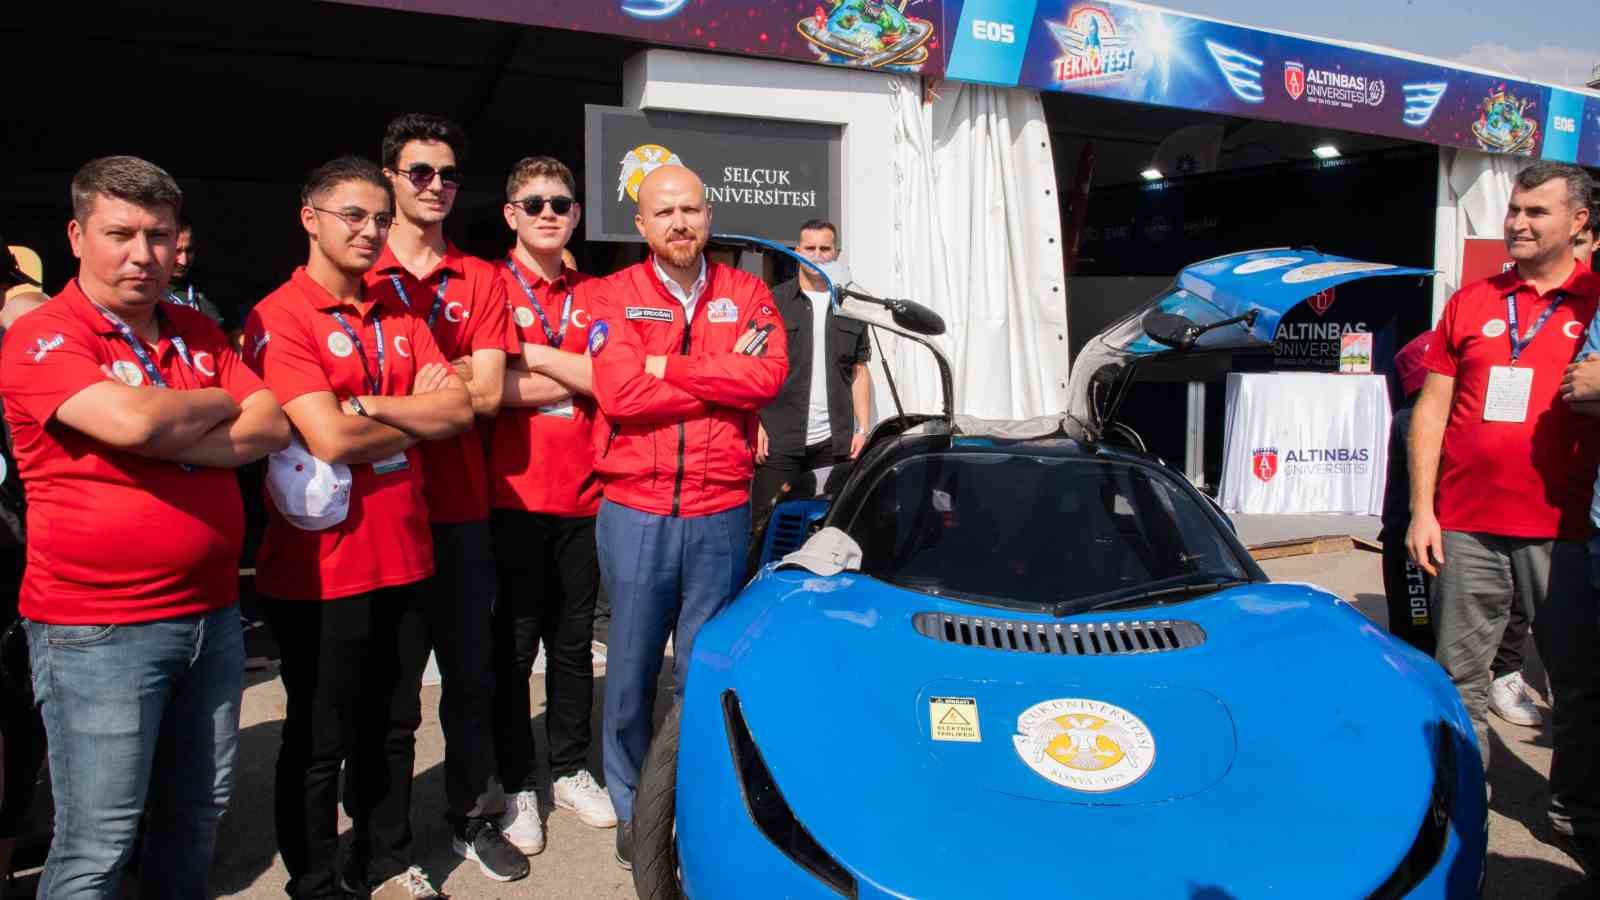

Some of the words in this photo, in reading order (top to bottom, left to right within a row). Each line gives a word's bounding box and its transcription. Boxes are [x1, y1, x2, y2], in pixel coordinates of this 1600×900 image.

[972, 19, 1015, 43] E05
[1055, 48, 1136, 81] TEKNOFEST
[723, 166, 791, 188] SELÇUK
